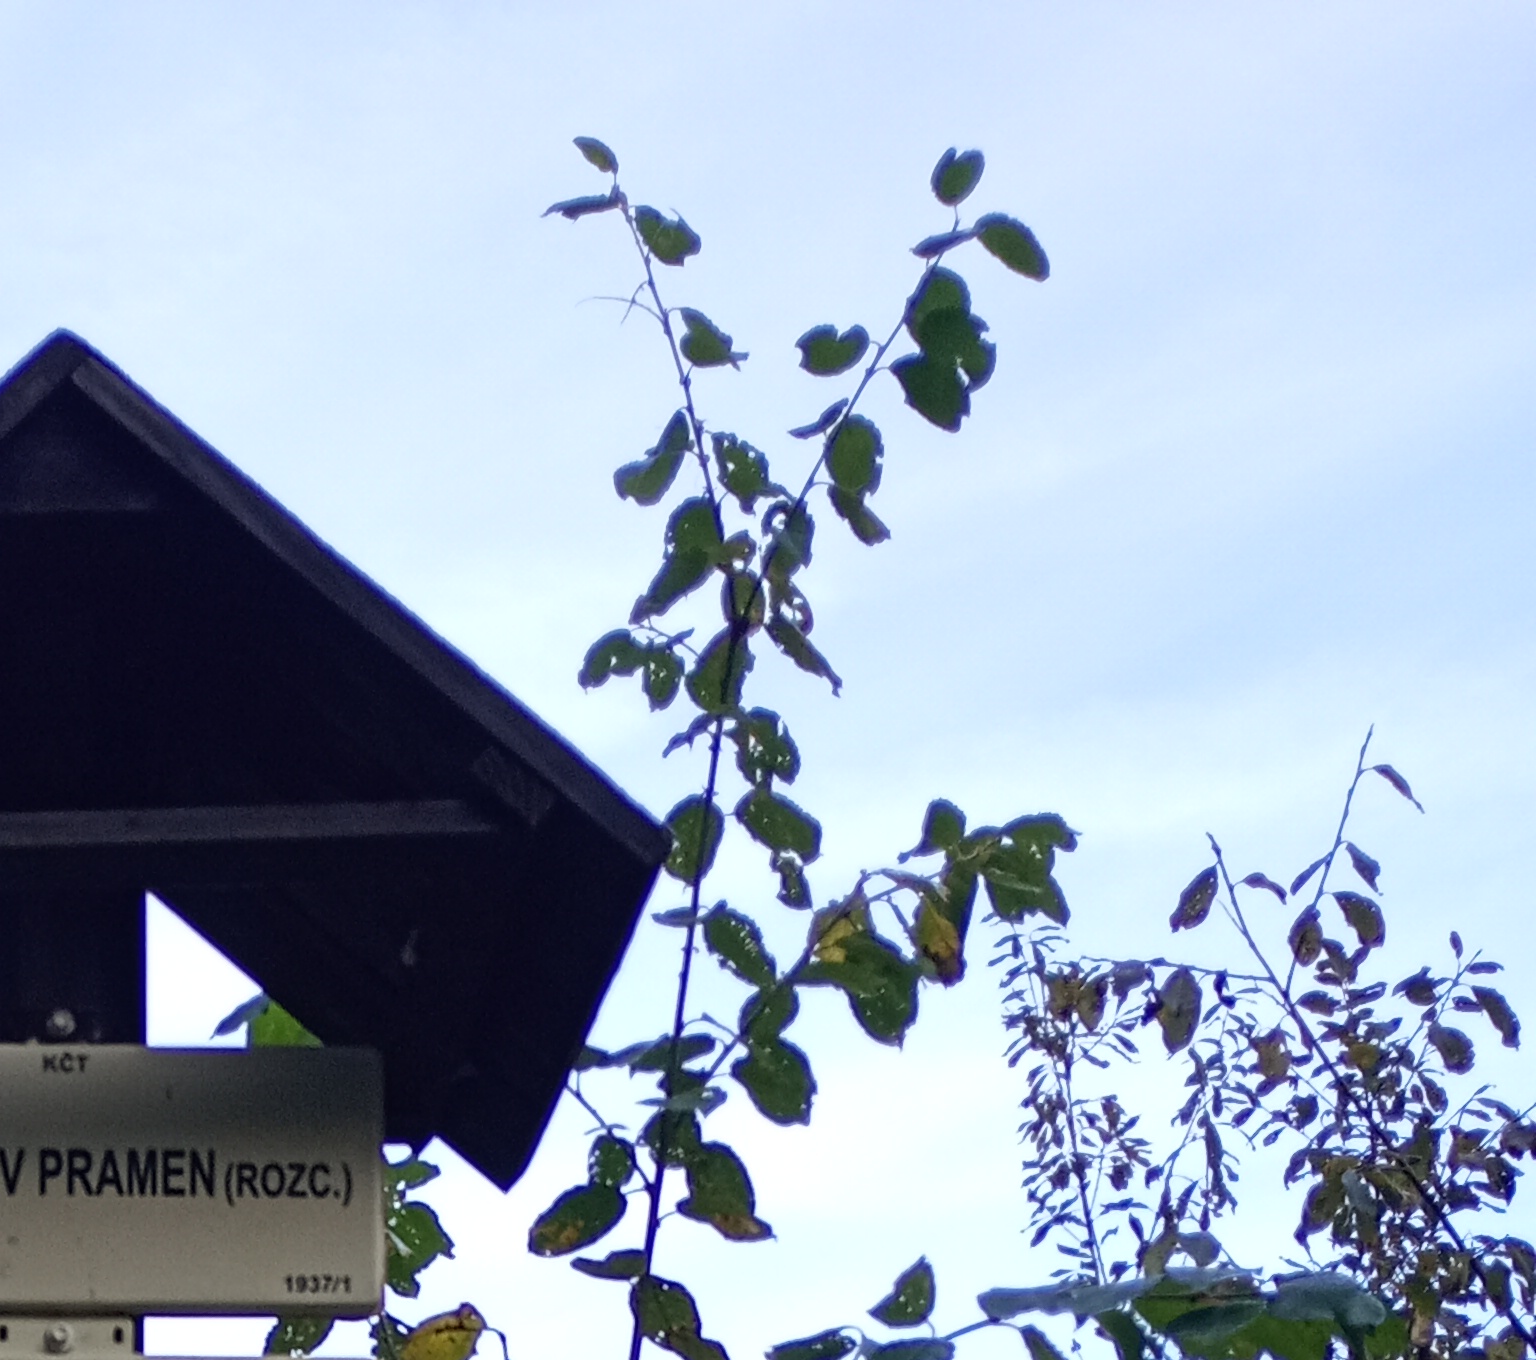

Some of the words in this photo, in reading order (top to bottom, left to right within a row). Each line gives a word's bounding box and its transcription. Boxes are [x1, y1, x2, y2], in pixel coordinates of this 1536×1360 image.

[42, 1052, 91, 1073] KČT
[38, 1147, 216, 1197] PRAMEN
[224, 1160, 353, 1206] (ROZC.)
[284, 1273, 352, 1294] 1937/1
